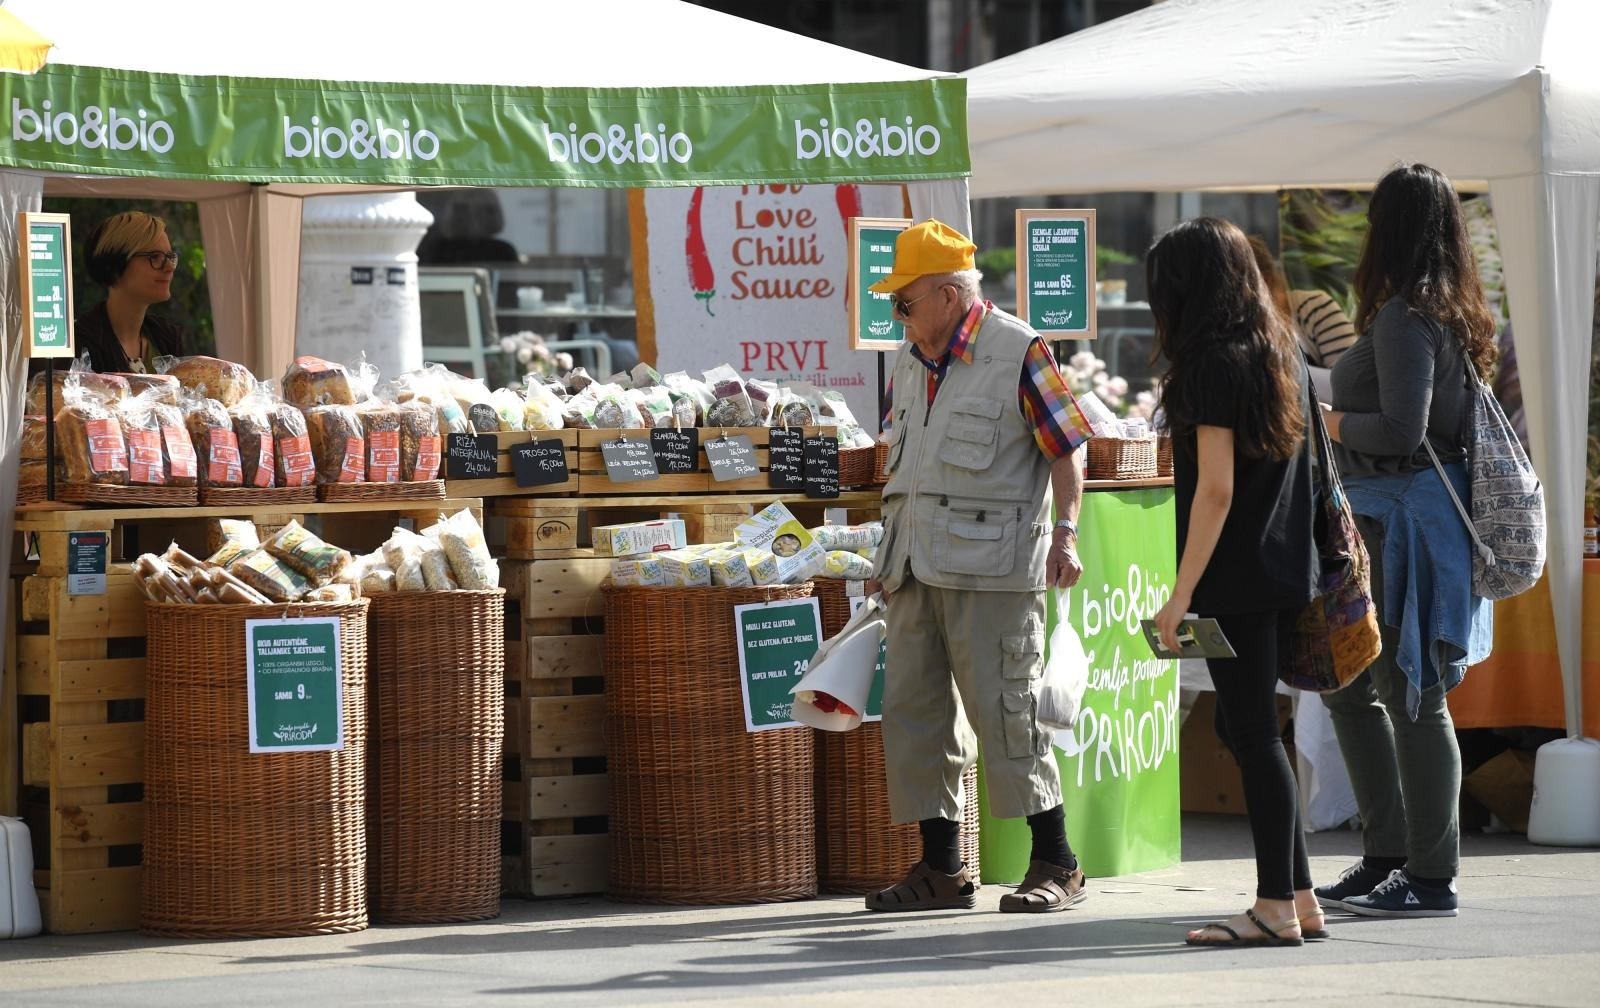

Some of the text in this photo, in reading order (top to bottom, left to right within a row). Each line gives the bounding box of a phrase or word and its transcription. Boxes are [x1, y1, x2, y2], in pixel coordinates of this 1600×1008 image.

[12, 97, 175, 154] bio&bio
[283, 115, 440, 161] bio&bio
[543, 122, 692, 165] bio&bio
[794, 115, 941, 160] bio&bio
[735, 200, 817, 230] Love
[731, 270, 835, 301] Sauce
[1060, 274, 1072, 289] 65
[740, 340, 829, 372] PRVI
[830, 372, 865, 386] umak
[455, 434, 477, 449] RIŽA
[450, 447, 491, 461] INTEGRALNA
[518, 448, 549, 459] PROSO
[1083, 564, 1170, 638] bio&bio
[761, 621, 772, 629] BEZ
[747, 640, 758, 648] BEZ
[793, 659, 810, 676] 24
[274, 691, 293, 700] SAMO
[297, 683, 306, 700] 9
[771, 709, 792, 720] PRIR
[279, 730, 314, 743] PRIRODA
[1075, 690, 1178, 788] PRIRODA
